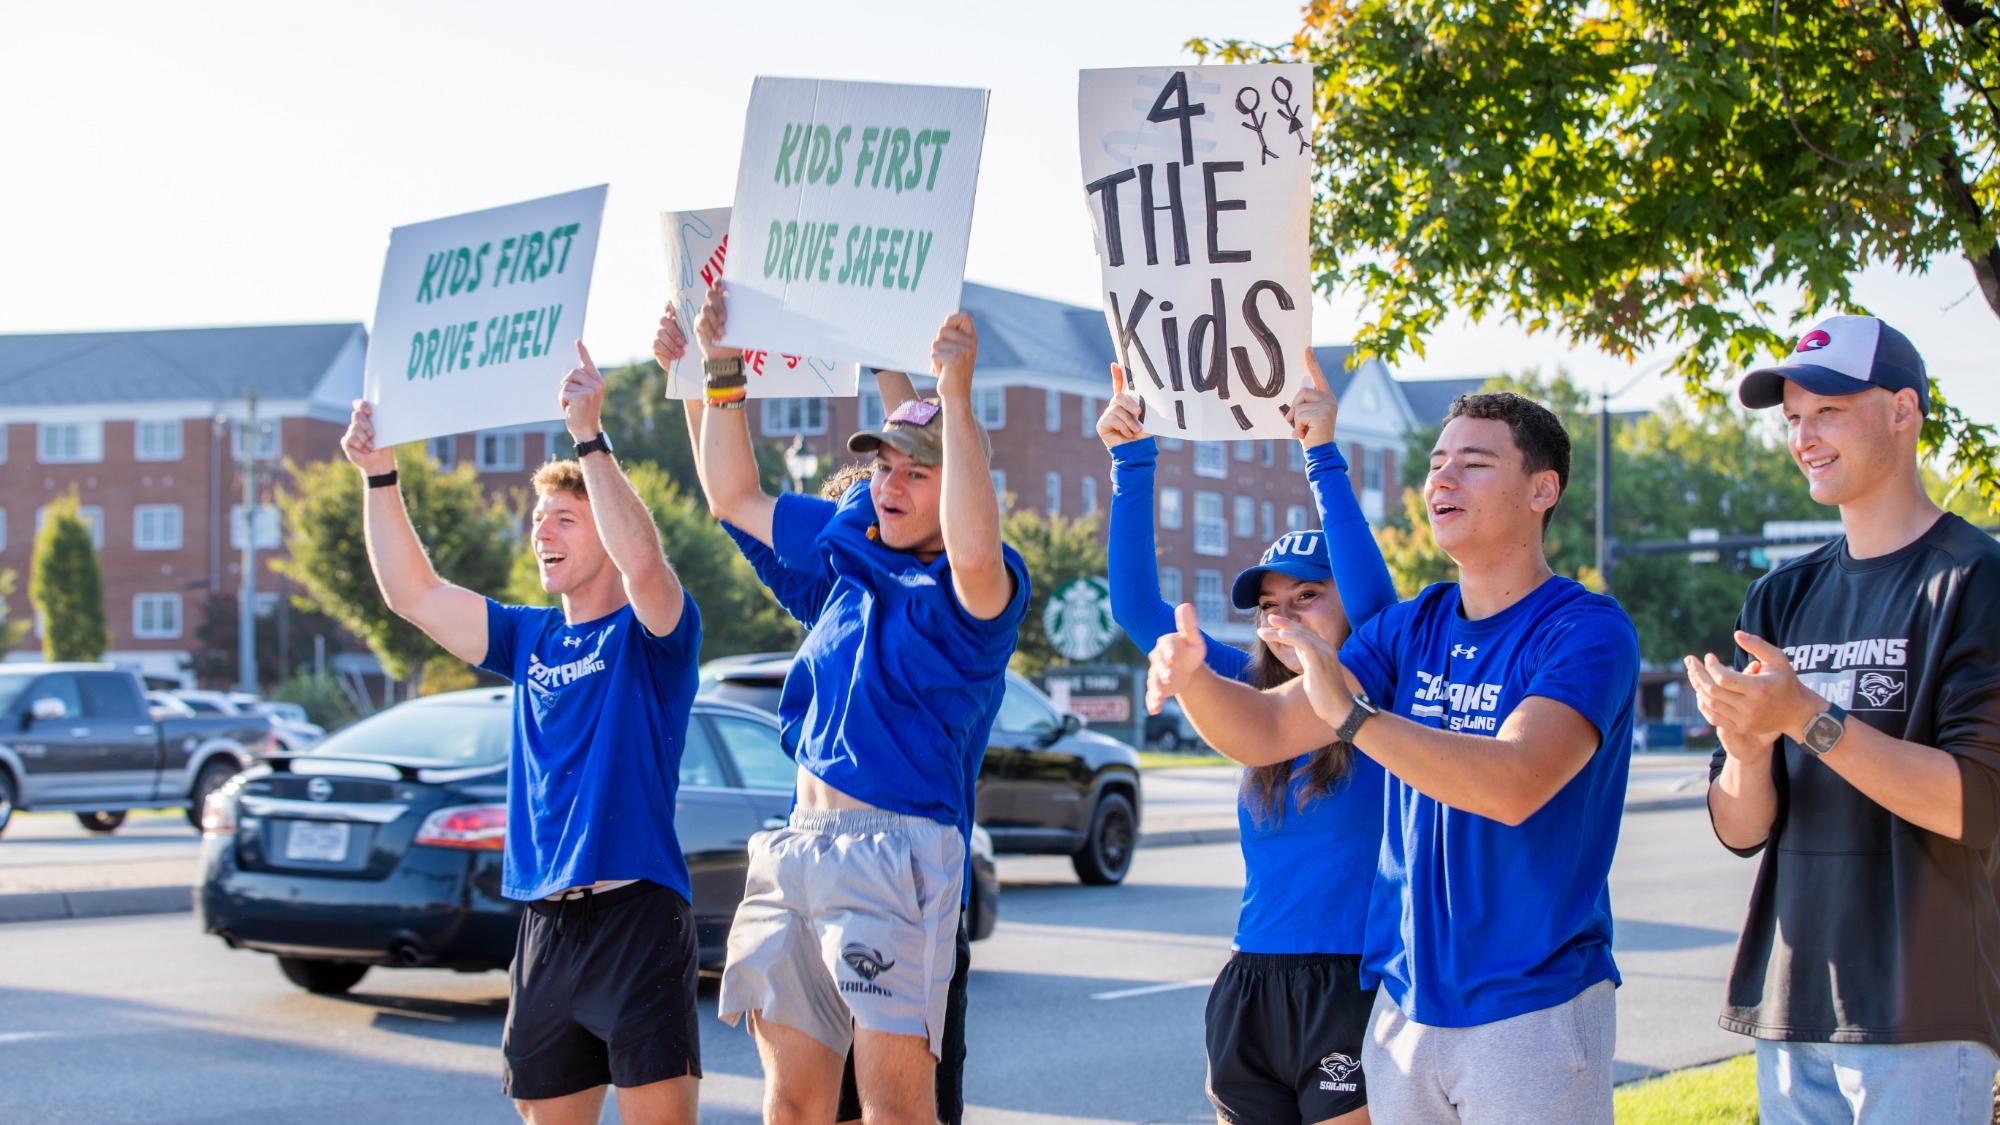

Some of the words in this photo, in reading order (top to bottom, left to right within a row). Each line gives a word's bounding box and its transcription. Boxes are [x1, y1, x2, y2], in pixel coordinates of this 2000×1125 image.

[1146, 71, 1206, 167] 4
[774, 121, 852, 188] KIDS
[853, 126, 951, 194] FIRST
[1085, 161, 1252, 267] THE
[416, 241, 492, 304] KIDS
[493, 222, 581, 288] FIRST
[699, 233, 729, 289] KID
[763, 219, 839, 284] DRIVE
[837, 223, 933, 292] SAFELY
[407, 320, 478, 382] DRIVE
[478, 304, 562, 368] SAFELY
[1449, 715, 1497, 731] SLING
[1319, 1080, 1357, 1092] SAILING
